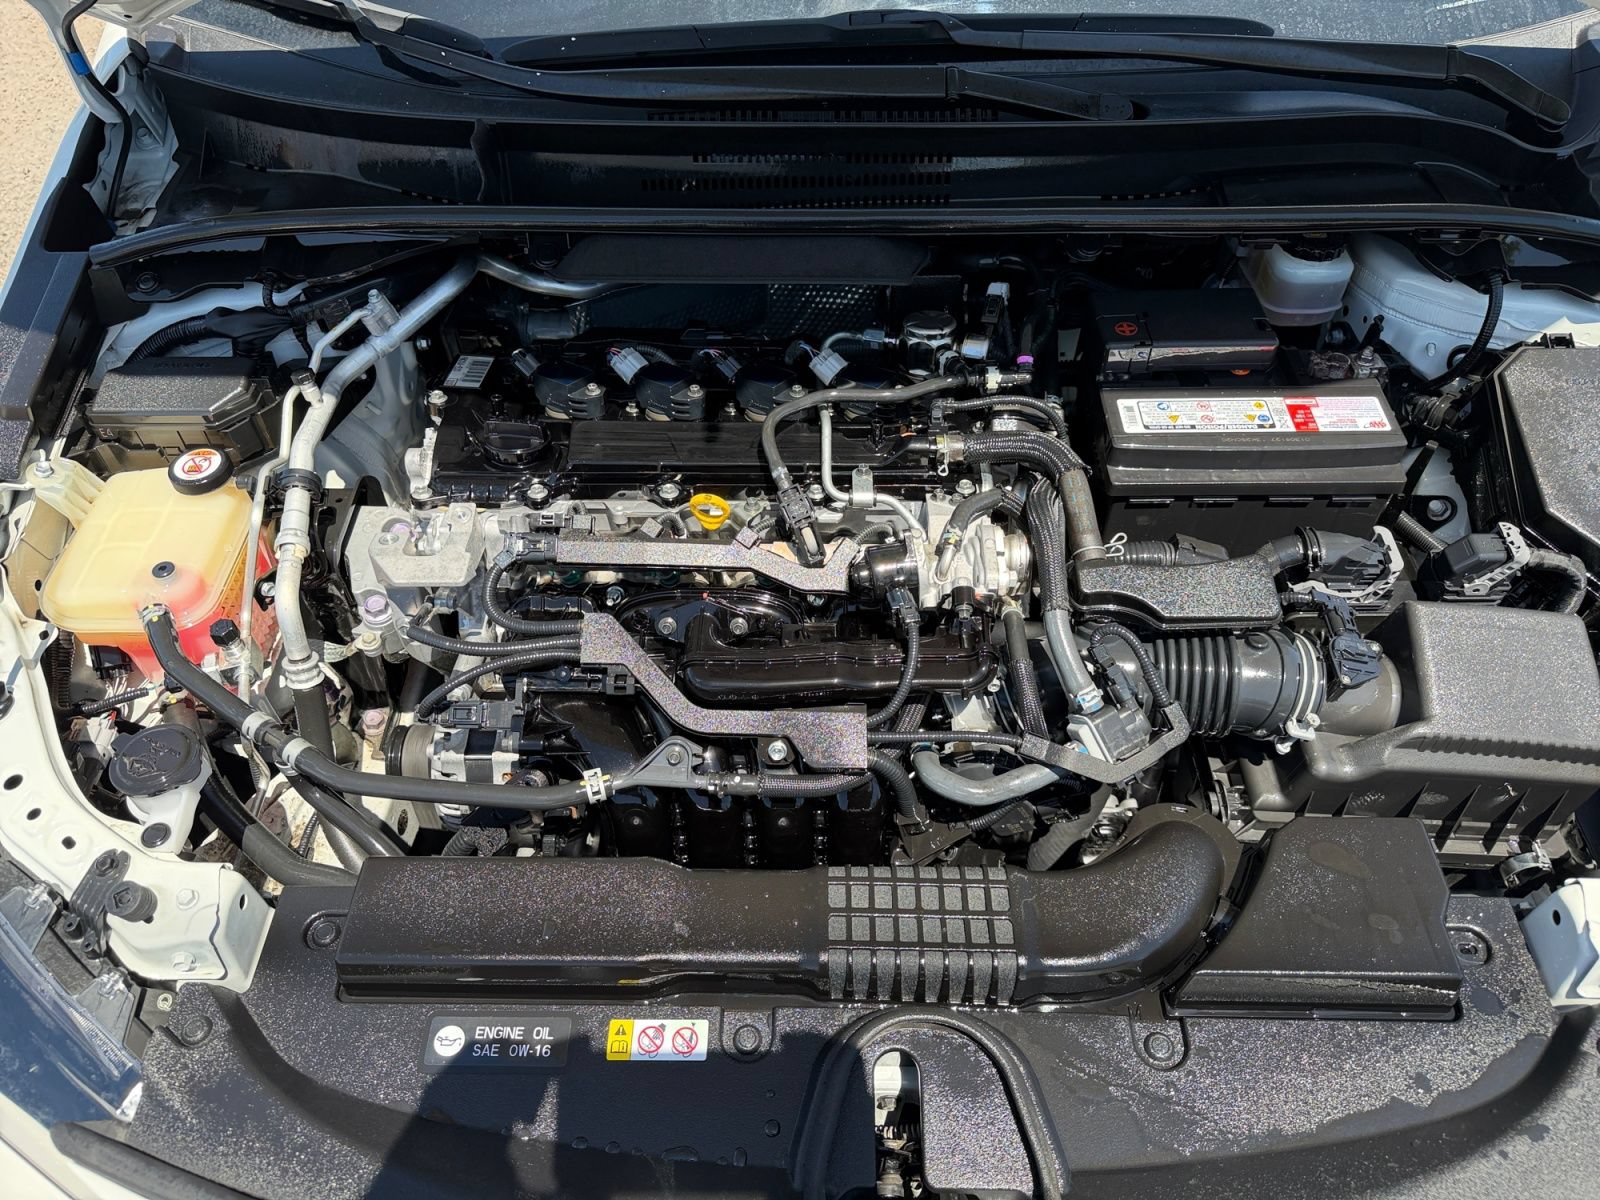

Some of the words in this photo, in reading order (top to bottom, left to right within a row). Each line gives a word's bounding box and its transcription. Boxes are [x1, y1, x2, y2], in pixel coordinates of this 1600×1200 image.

[475, 1026, 525, 1039] ENGINE
[533, 1026, 554, 1040] OIL
[472, 1044, 500, 1057] SAE
[509, 1044, 551, 1057] 0W-16
